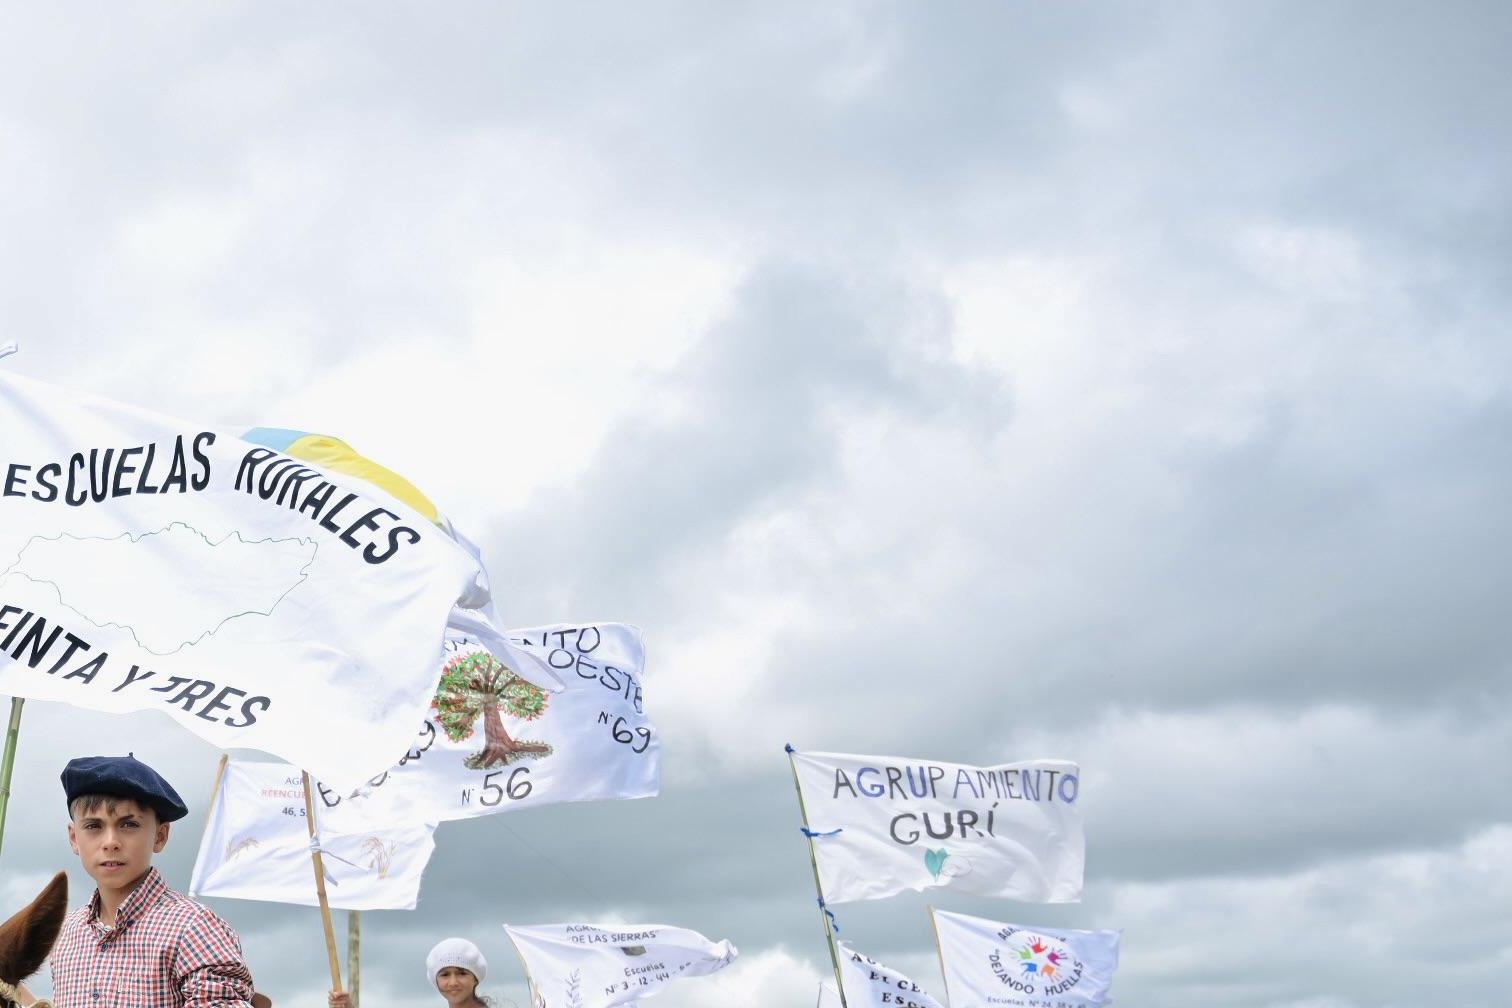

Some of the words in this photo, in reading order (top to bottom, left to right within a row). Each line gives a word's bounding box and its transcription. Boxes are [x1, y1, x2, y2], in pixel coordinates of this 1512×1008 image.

[2, 431, 216, 507] ESCUELAS
[234, 447, 421, 565] RURALES
[112, 665, 156, 692] Y
[150, 676, 271, 727] TRES
[612, 717, 651, 753] 69
[480, 767, 533, 806] 56
[833, 766, 1079, 804] AGRUPAMIENTO
[890, 802, 999, 845] GURÍ
[588, 934, 608, 943] LAS
[624, 962, 665, 977] Escuelas
[638, 976, 648, 986] 12
[655, 972, 670, 982] 44
